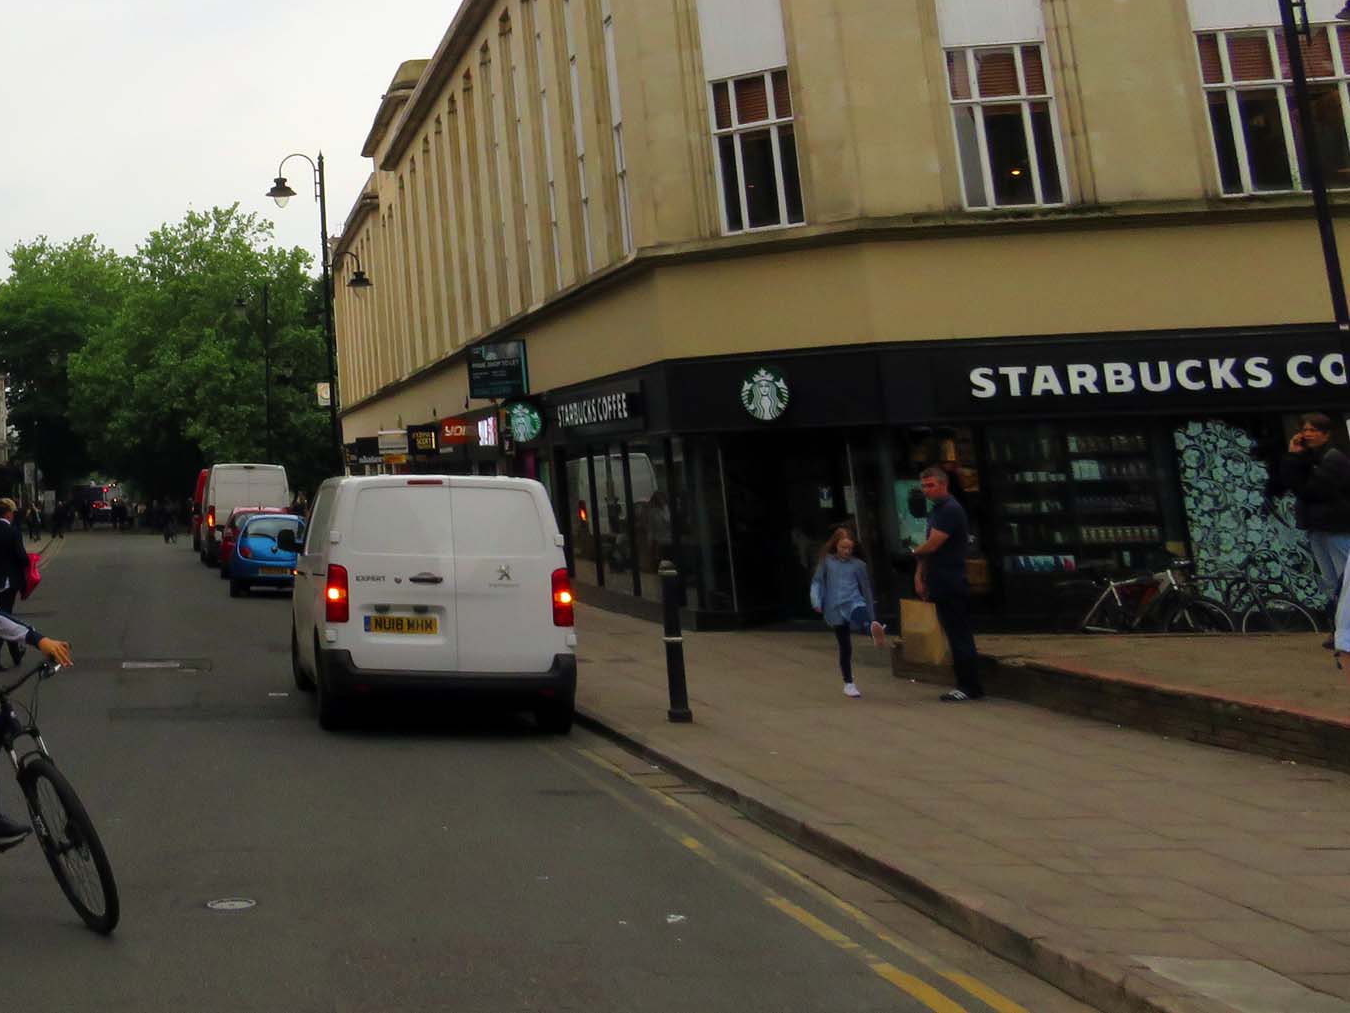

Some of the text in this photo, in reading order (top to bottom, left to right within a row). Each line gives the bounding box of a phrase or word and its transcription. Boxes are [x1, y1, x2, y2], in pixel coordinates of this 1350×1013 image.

[968, 357, 1274, 399] STARBUCKS
[557, 392, 628, 428] STARBUCKS COFFEE
